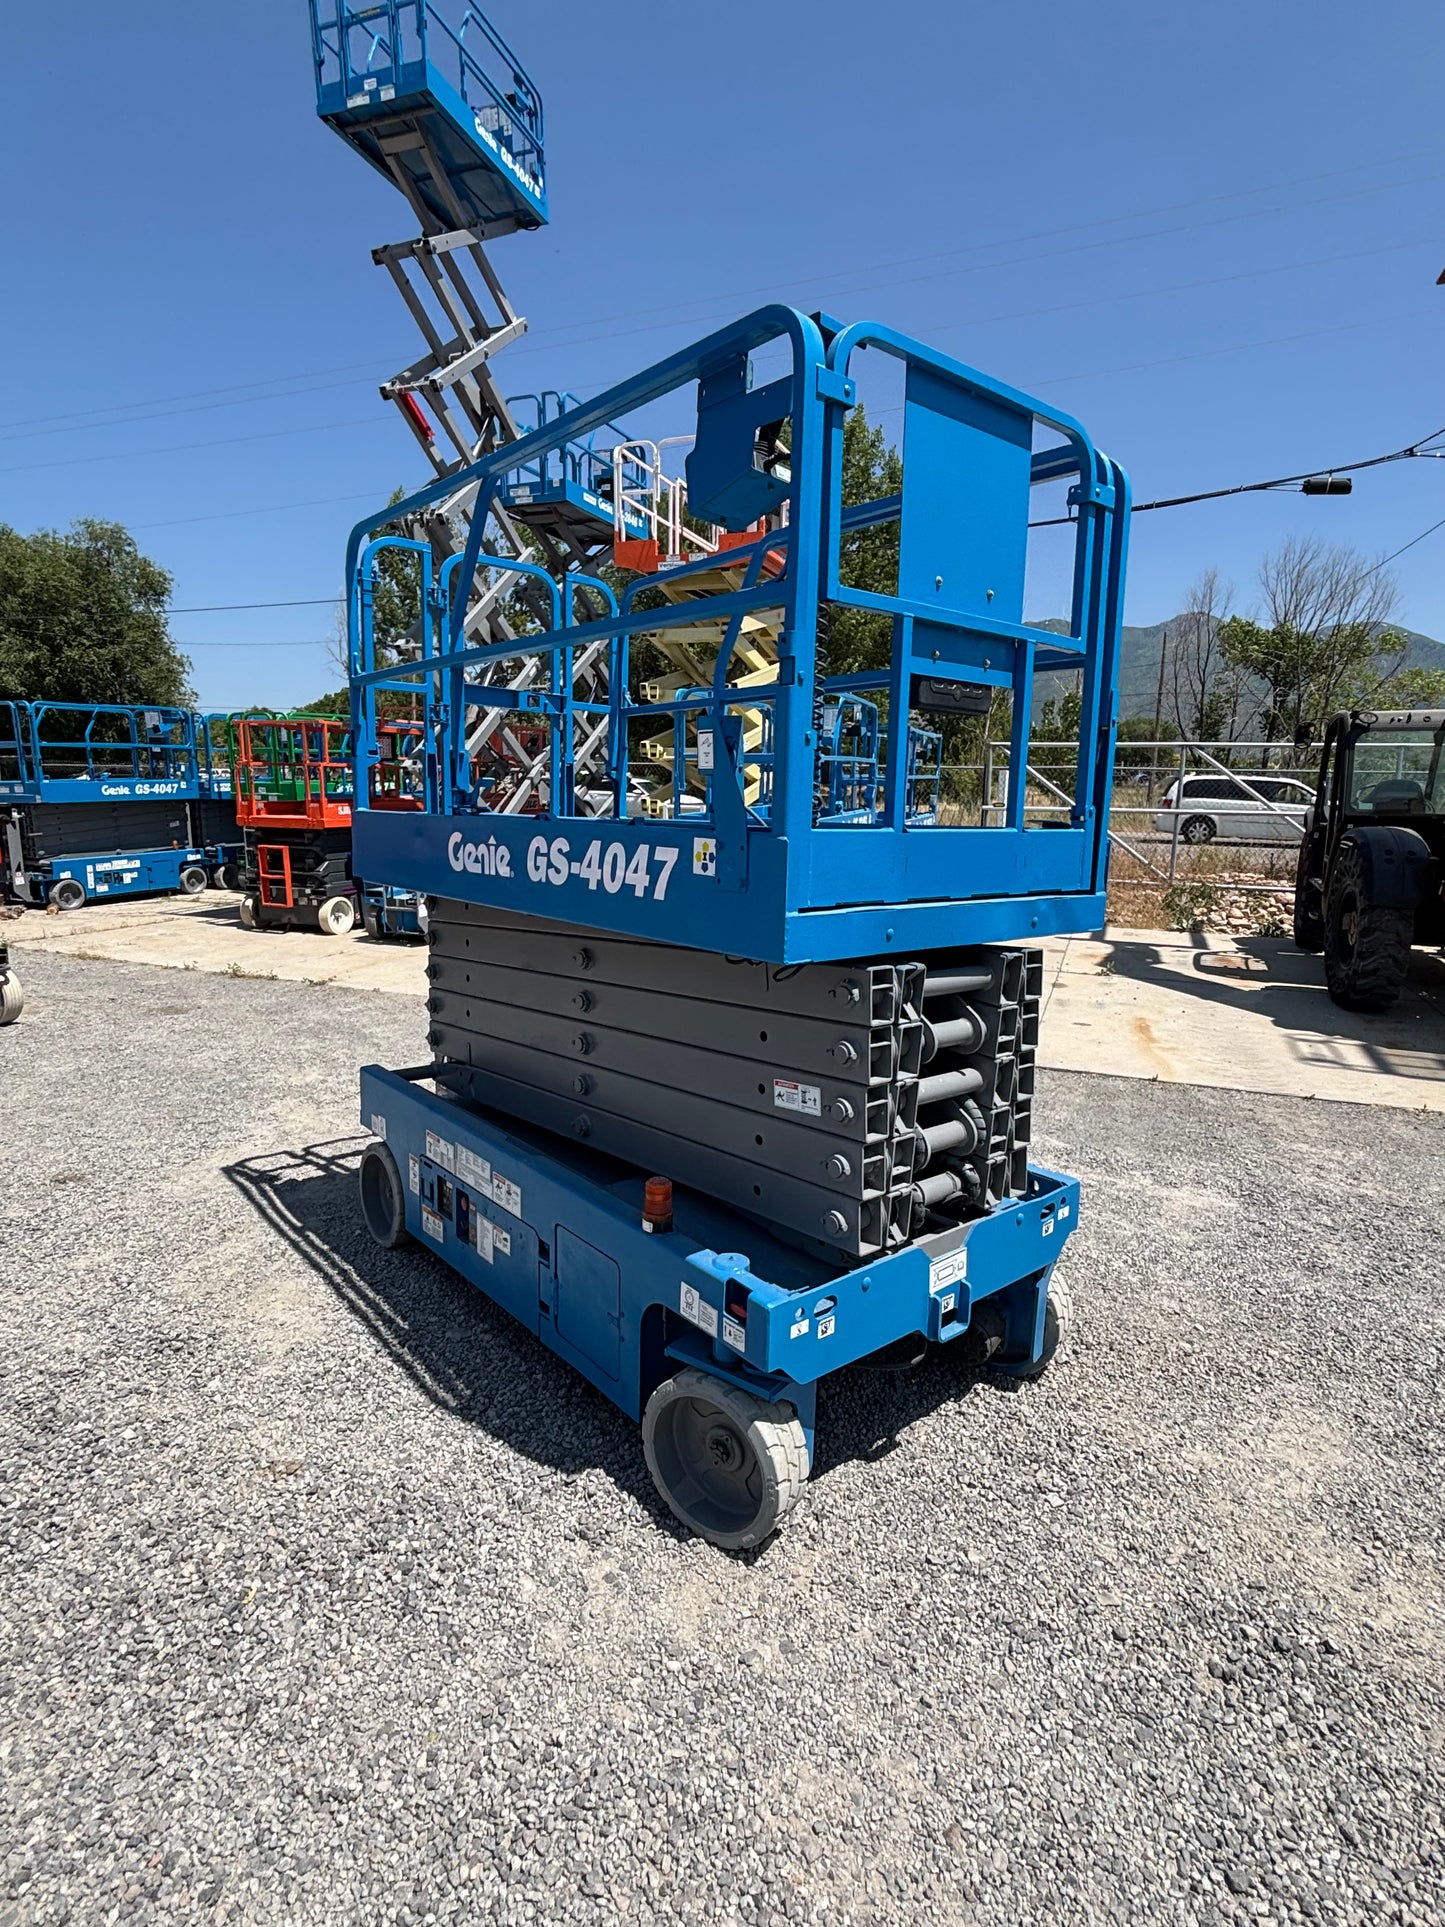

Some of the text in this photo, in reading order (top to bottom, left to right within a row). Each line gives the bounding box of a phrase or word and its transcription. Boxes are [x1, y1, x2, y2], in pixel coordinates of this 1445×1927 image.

[101, 784, 178, 795] Genie GS-4047
[448, 832, 679, 901] Genie GS-4047
